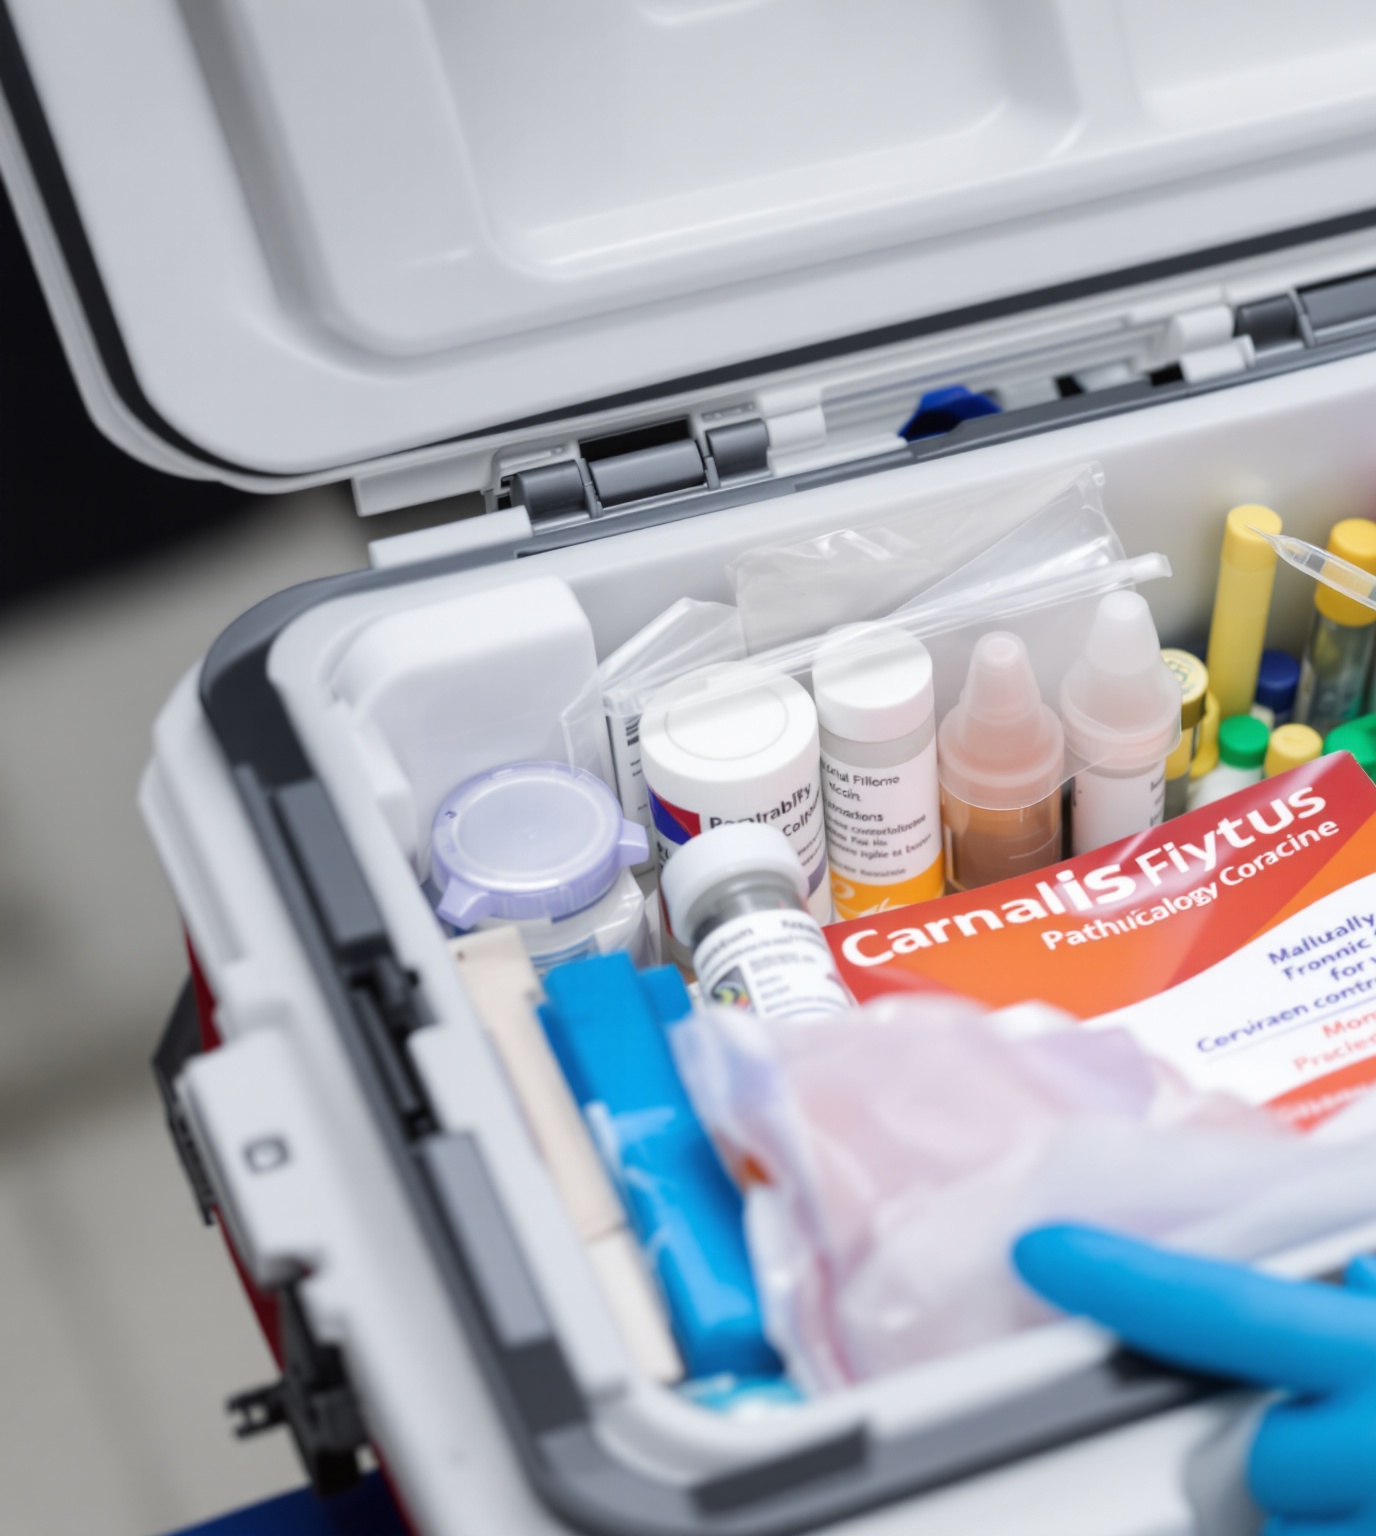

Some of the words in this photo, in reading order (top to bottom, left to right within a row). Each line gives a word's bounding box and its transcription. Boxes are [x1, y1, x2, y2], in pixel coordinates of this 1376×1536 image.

[841, 863, 1137, 968] Carnalis
[1134, 786, 1327, 888] Fiytus
[1218, 819, 1340, 886] Coracine
[1329, 960, 1365, 981] for
